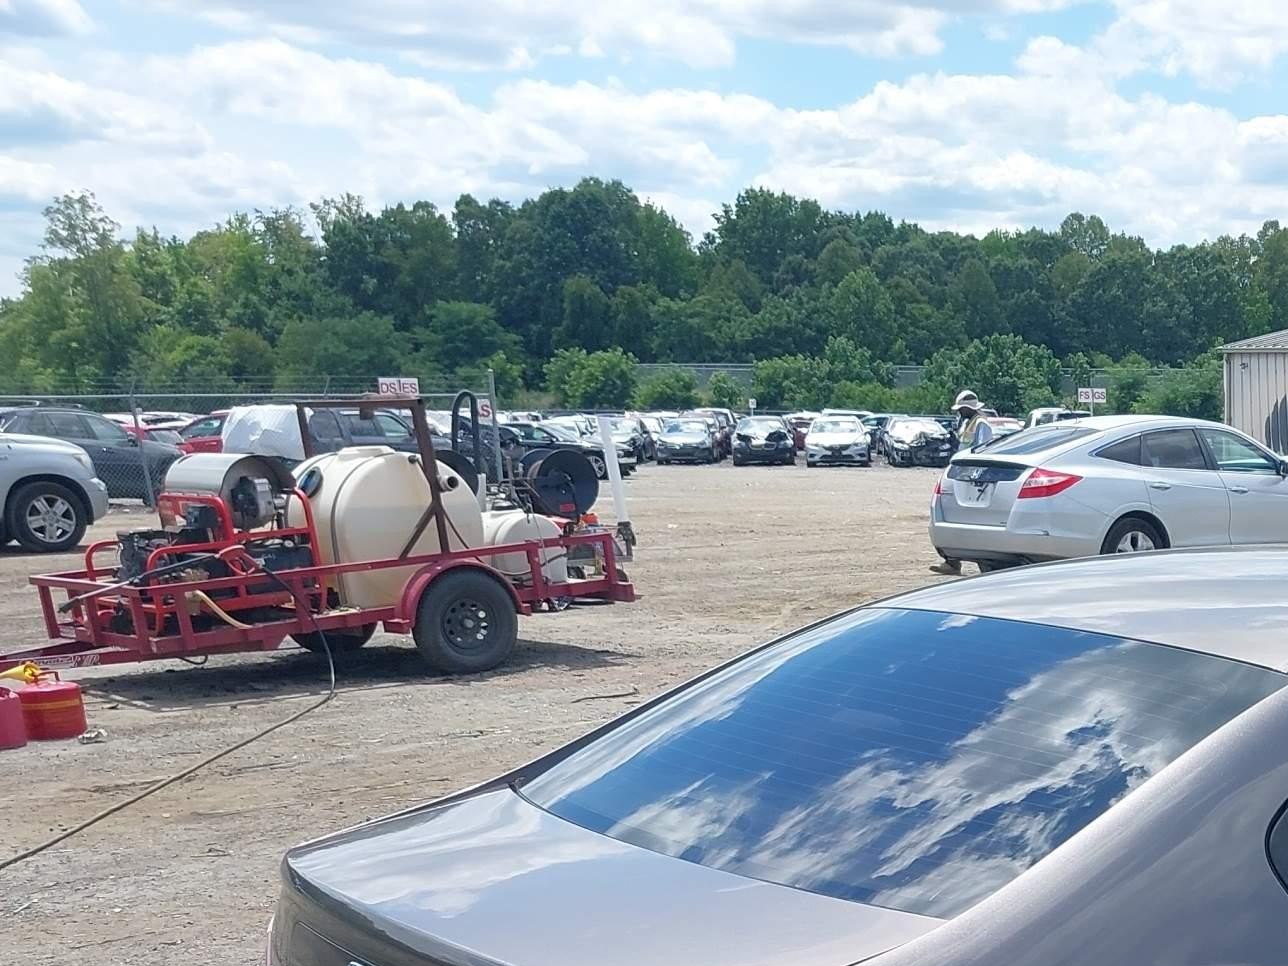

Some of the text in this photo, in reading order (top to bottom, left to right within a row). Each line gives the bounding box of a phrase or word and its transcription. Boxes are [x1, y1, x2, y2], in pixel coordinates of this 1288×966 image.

[381, 383, 418, 393] DS ES
[1079, 391, 1106, 400] FS GS
